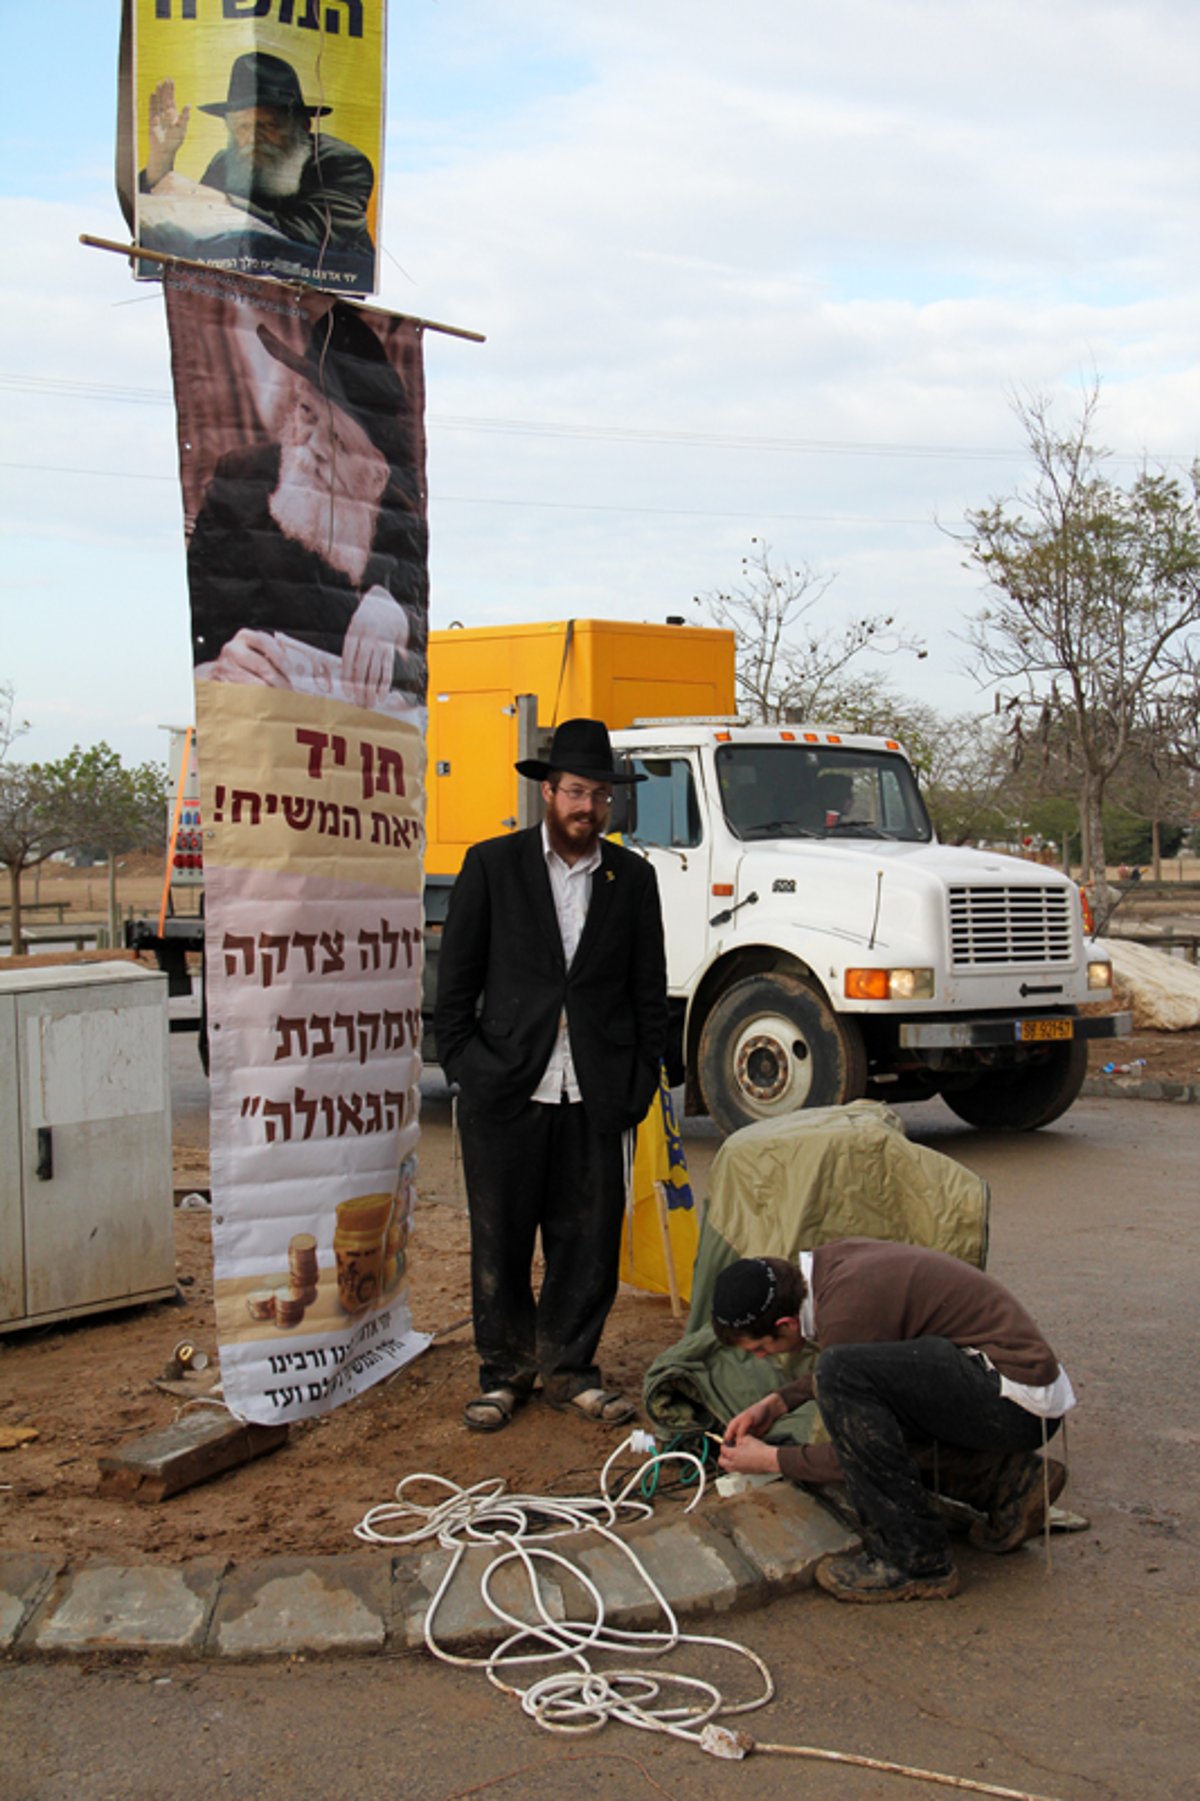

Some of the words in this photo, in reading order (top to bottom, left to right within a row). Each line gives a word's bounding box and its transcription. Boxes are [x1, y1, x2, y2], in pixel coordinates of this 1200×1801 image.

[296, 728, 347, 779] יד
[360, 742, 406, 800] תן
[213, 785, 362, 840] המשיח!
[371, 811, 425, 850] יאת
[222, 930, 345, 988] צדקה
[267, 1350, 328, 1375] ורבינו
[263, 1384, 304, 1408] ועד
